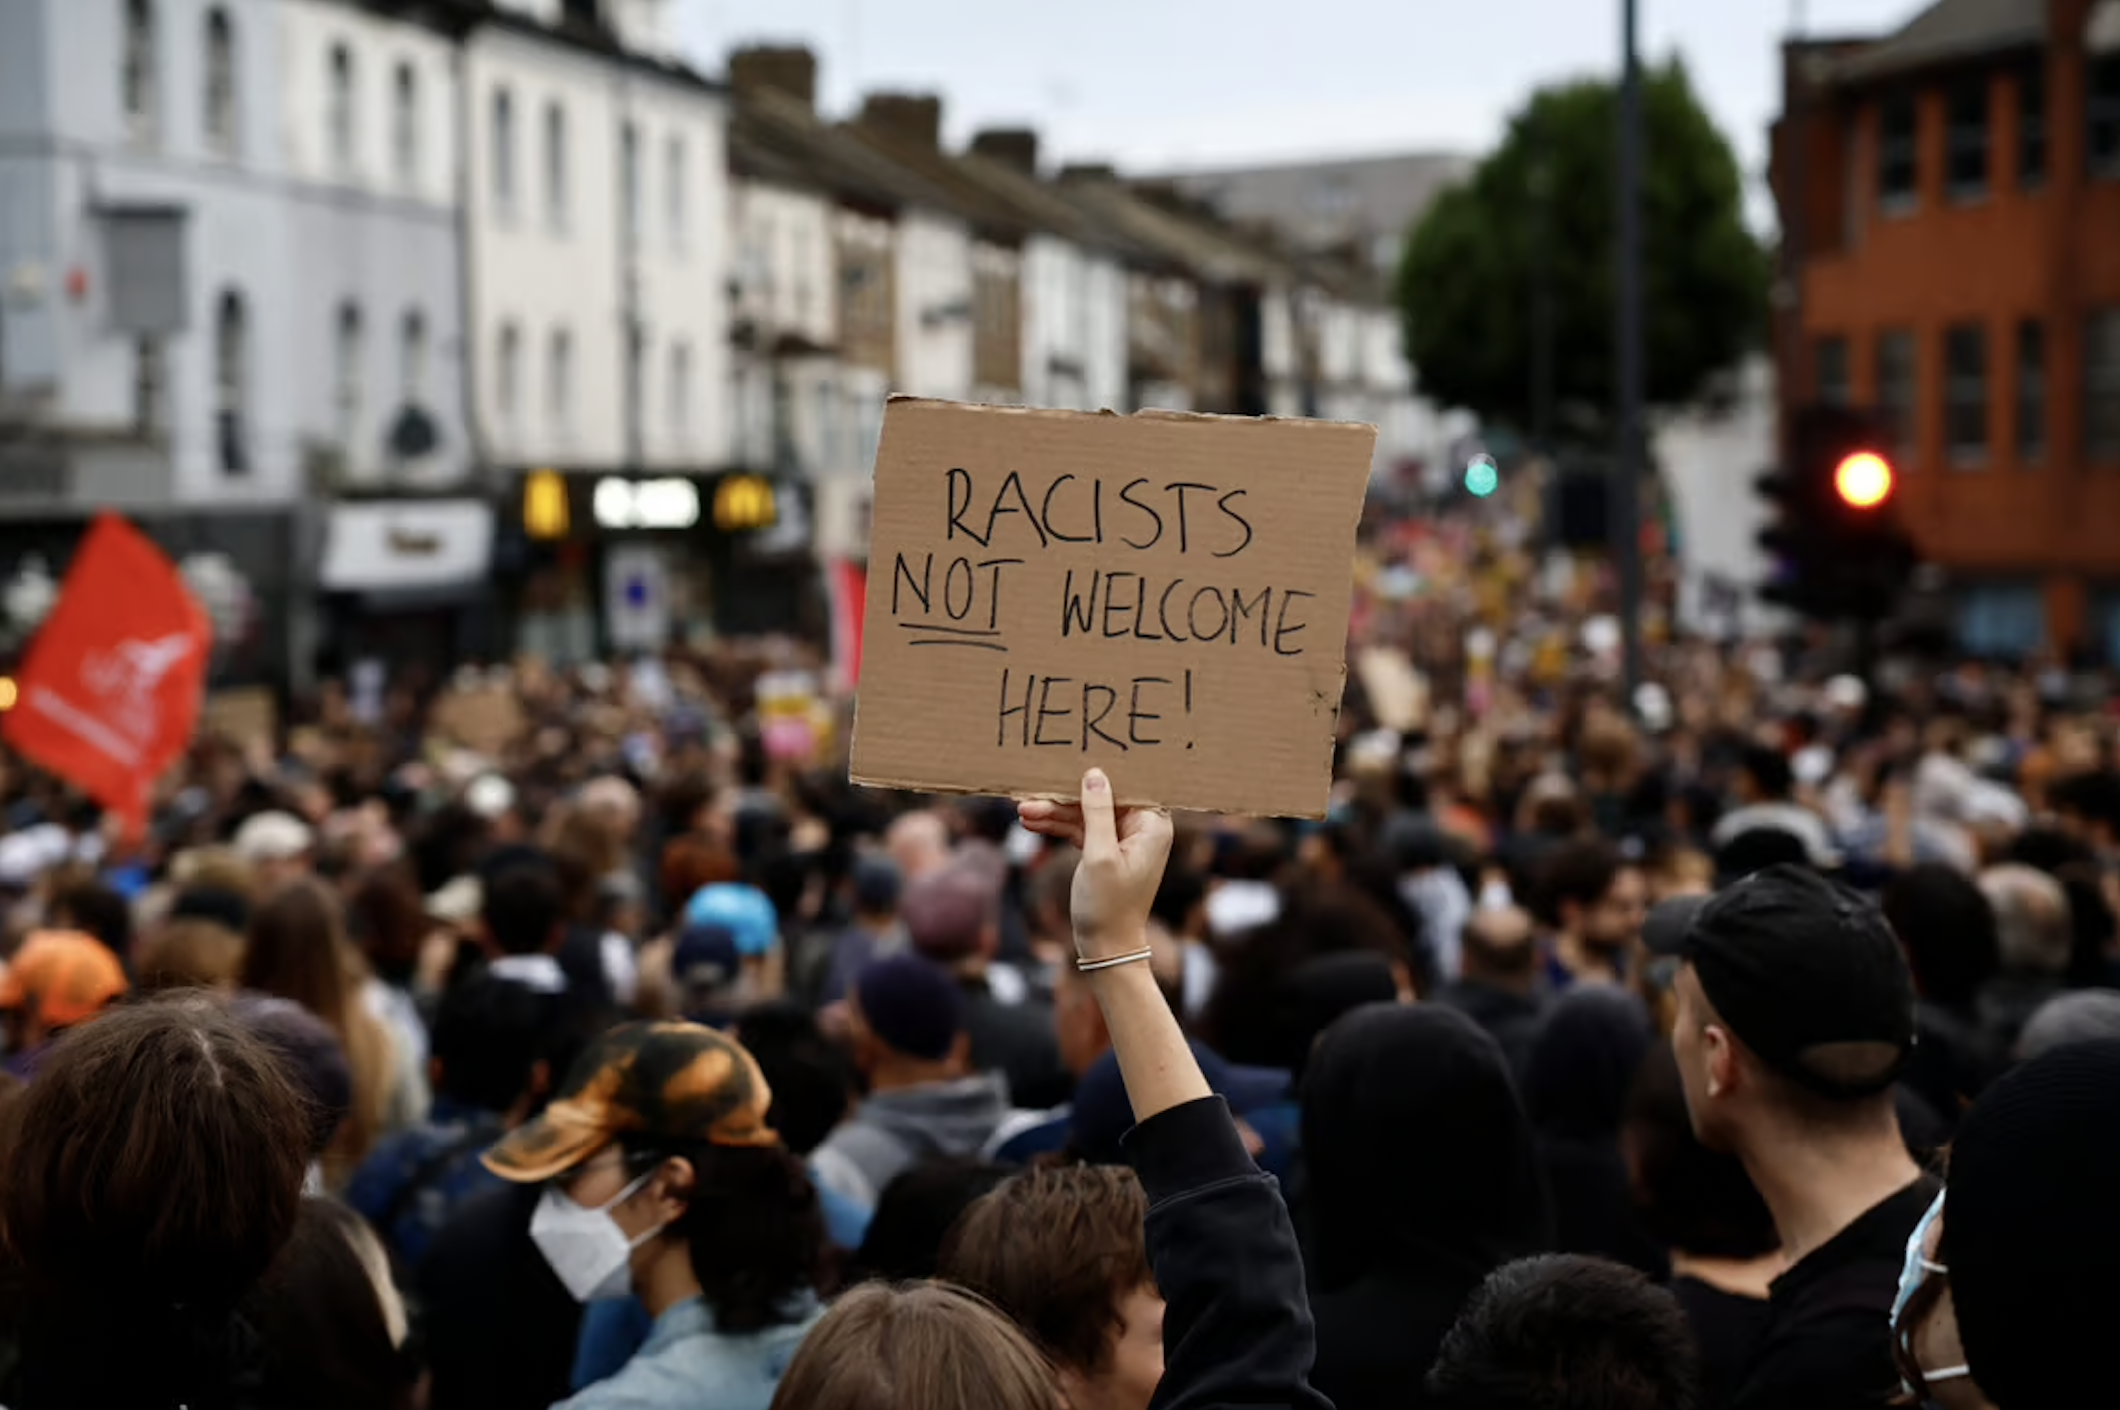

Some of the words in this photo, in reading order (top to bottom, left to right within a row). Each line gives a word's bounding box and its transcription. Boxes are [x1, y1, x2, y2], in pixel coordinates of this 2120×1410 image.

[944, 467, 1254, 557] RACISTS
[892, 553, 1024, 629] NOT
[1061, 569, 1316, 655] WELCOME
[998, 668, 1194, 752] HERE!
